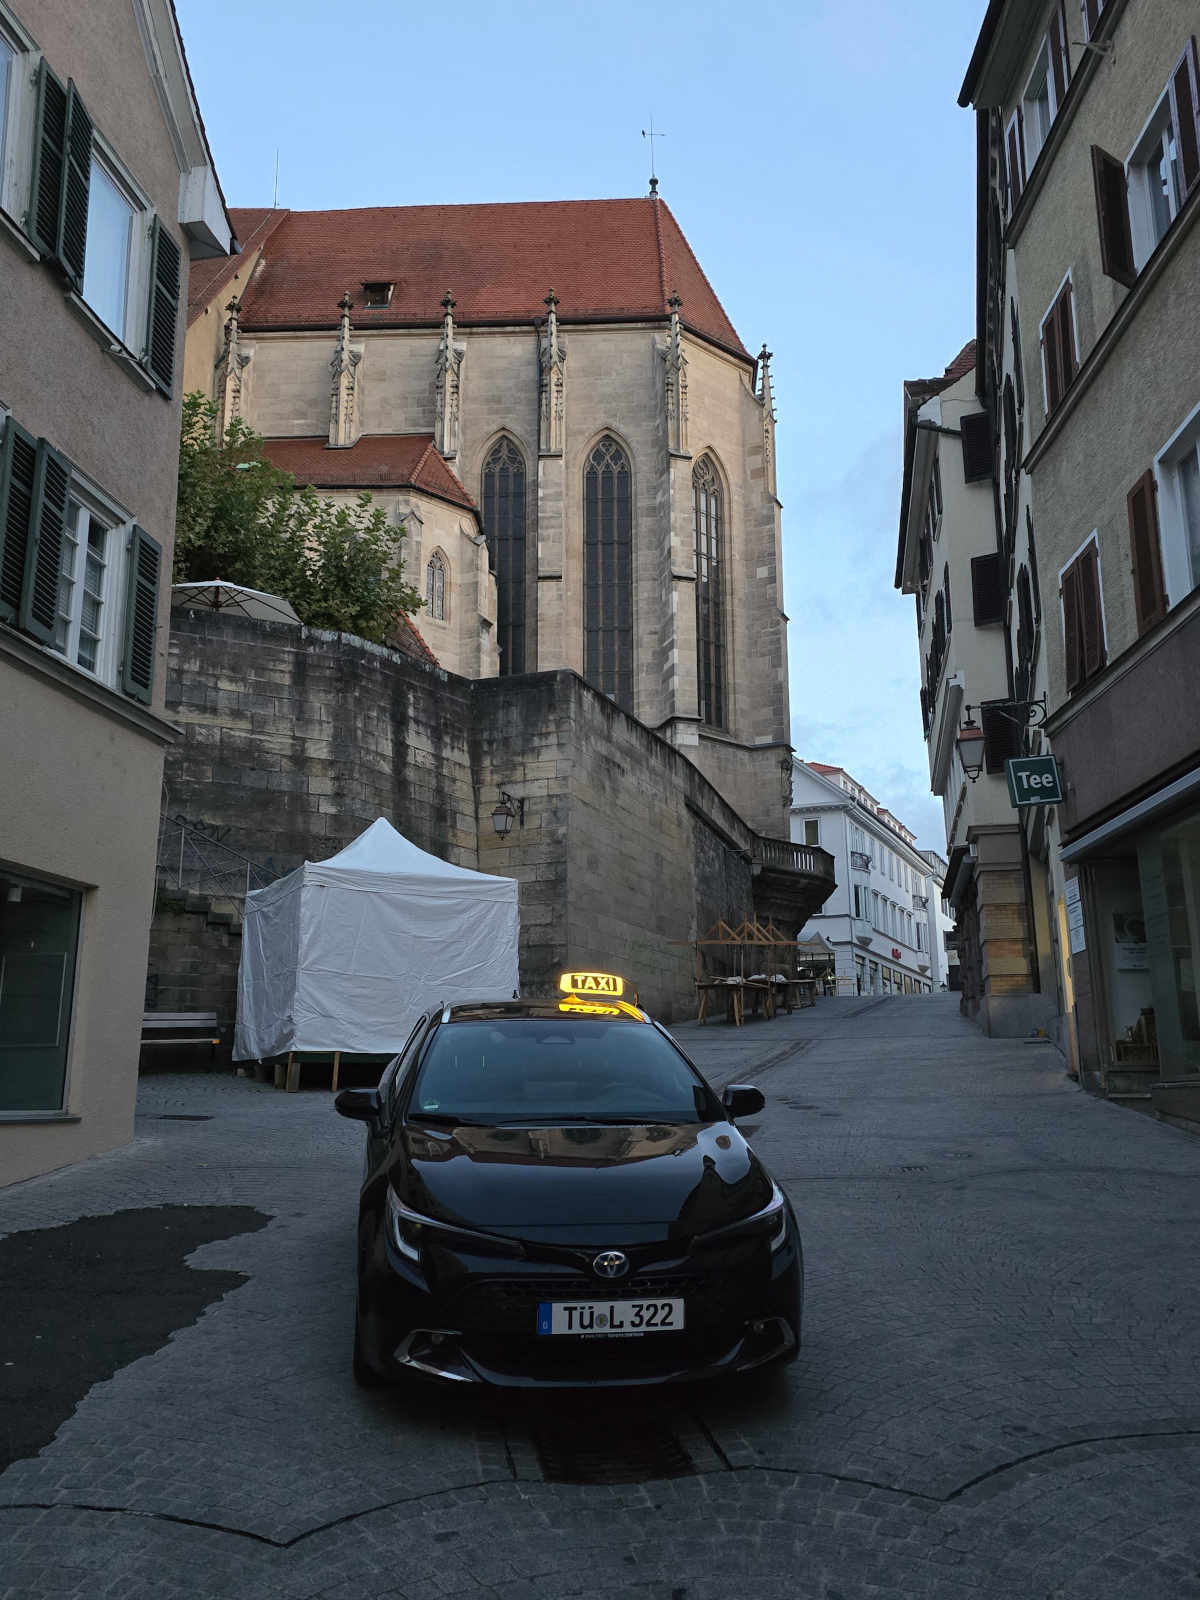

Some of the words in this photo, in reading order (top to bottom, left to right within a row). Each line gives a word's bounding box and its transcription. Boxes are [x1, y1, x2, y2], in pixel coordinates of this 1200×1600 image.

[1017, 772, 1054, 789] Tee
[574, 975, 614, 991] TAXI
[563, 1306, 594, 1330] TÜ
[609, 1305, 624, 1328] L
[630, 1302, 673, 1328] 322
